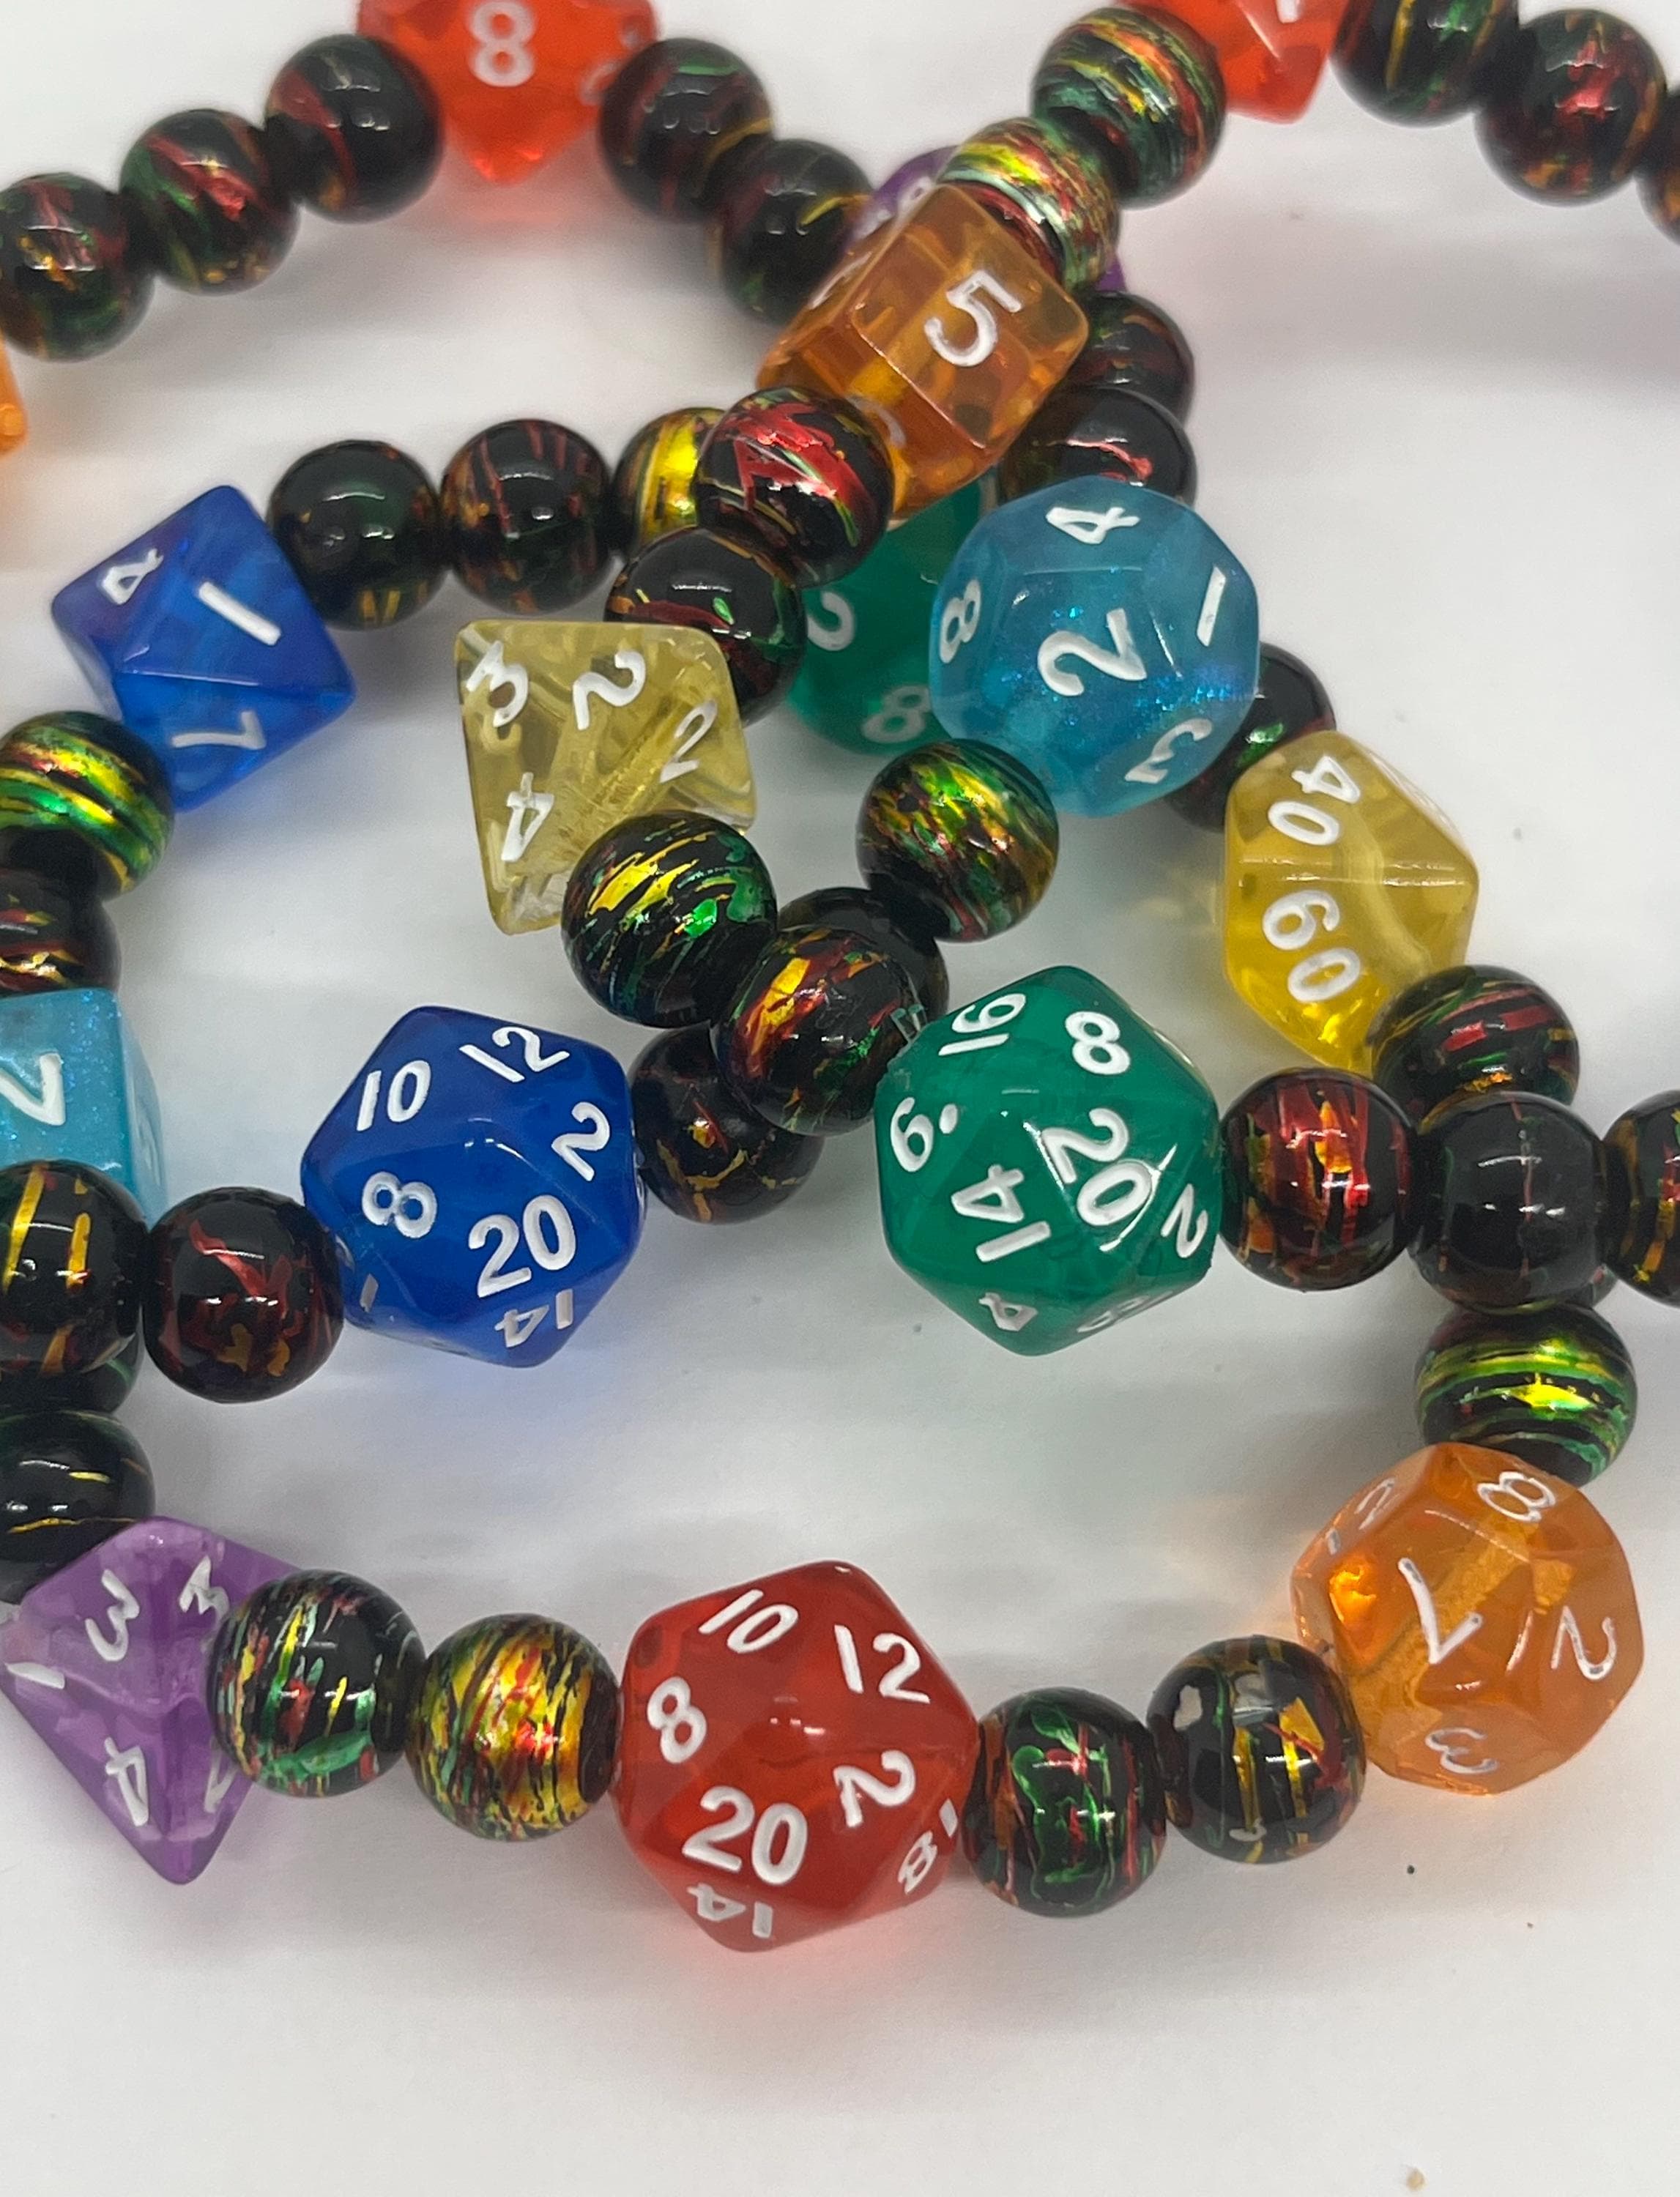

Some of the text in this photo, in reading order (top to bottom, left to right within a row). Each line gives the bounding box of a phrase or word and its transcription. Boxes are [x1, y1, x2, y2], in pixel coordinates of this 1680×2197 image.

[469, 0, 535, 87] 8
[924, 269, 1023, 367] 5
[1046, 506, 1140, 544] 4
[101, 547, 164, 606] 4
[198, 581, 282, 646] 1
[1196, 566, 1226, 647] 1
[940, 579, 981, 663] 8
[1037, 608, 1148, 697] 2
[465, 639, 529, 728] 3
[573, 650, 647, 731] 2
[861, 684, 932, 744] 8
[171, 710, 267, 751] 7
[659, 700, 718, 784] 2
[501, 772, 555, 862] 4
[1267, 754, 1361, 847] 40
[1261, 889, 1362, 1003] 60
[459, 1026, 570, 1083] 12
[938, 993, 1026, 1056] 16
[1064, 1010, 1131, 1075] 8
[356, 1060, 432, 1131] 10
[551, 1101, 611, 1181] 2
[1040, 1107, 1156, 1227] 20
[361, 1171, 438, 1239] 8
[951, 1164, 1052, 1263] 14
[1161, 1182, 1208, 1259] 2
[469, 1194, 577, 1298] 20
[494, 1288, 574, 1348] 14
[1477, 1471, 1557, 1523] 8
[84, 1569, 141, 1662] 3
[698, 1588, 799, 1654] 10
[1397, 1557, 1484, 1665] 7
[1550, 1605, 1617, 1681] 2
[833, 1624, 931, 1704] 12
[647, 1676, 707, 1764] 8
[1425, 1727, 1499, 1775] 3
[105, 1736, 149, 1827] 4
[832, 1749, 916, 1828] 2
[681, 1785, 808, 1886] 20
[686, 1882, 773, 1940] 14
